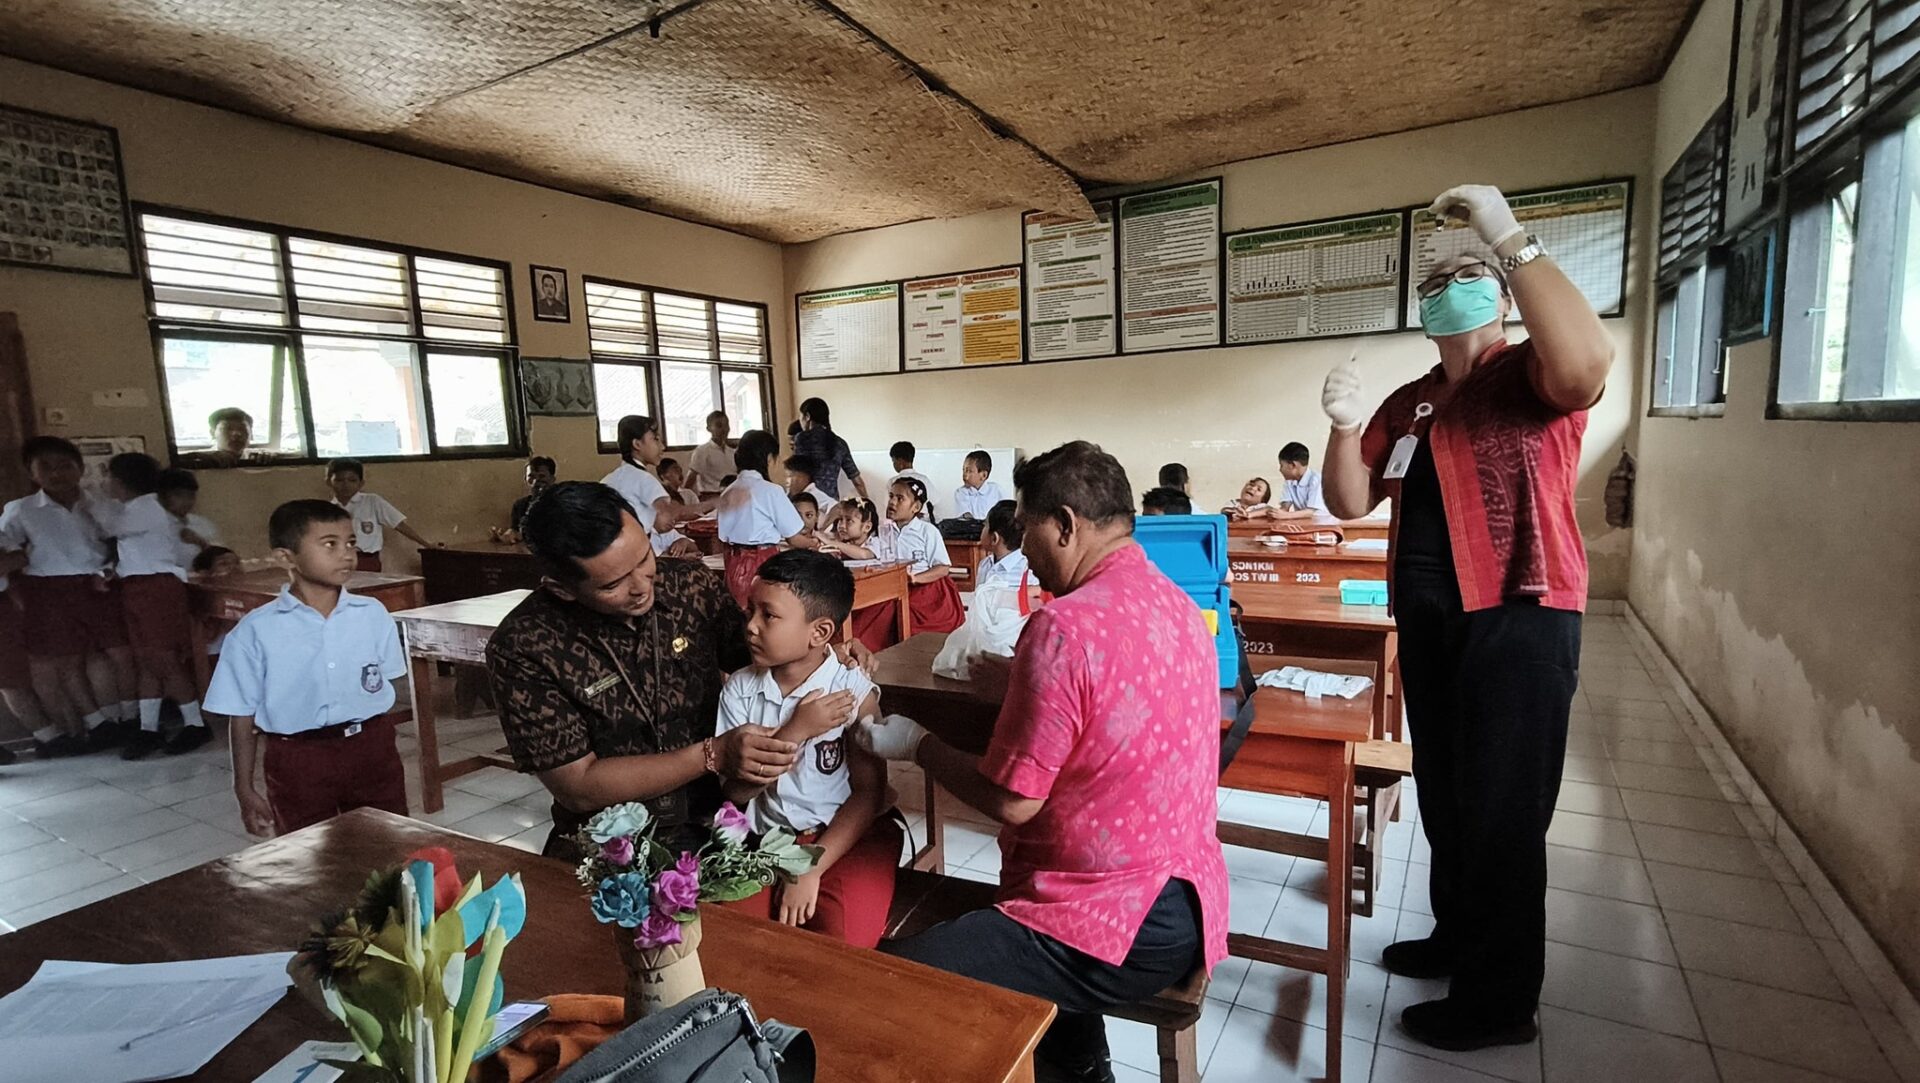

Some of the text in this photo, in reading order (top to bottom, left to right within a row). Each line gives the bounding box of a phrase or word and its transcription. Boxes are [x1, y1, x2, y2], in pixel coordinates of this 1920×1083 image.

[1233, 572, 1249, 581] OS
[1295, 572, 1321, 583] 2023
[1242, 640, 1274, 654] 2023
